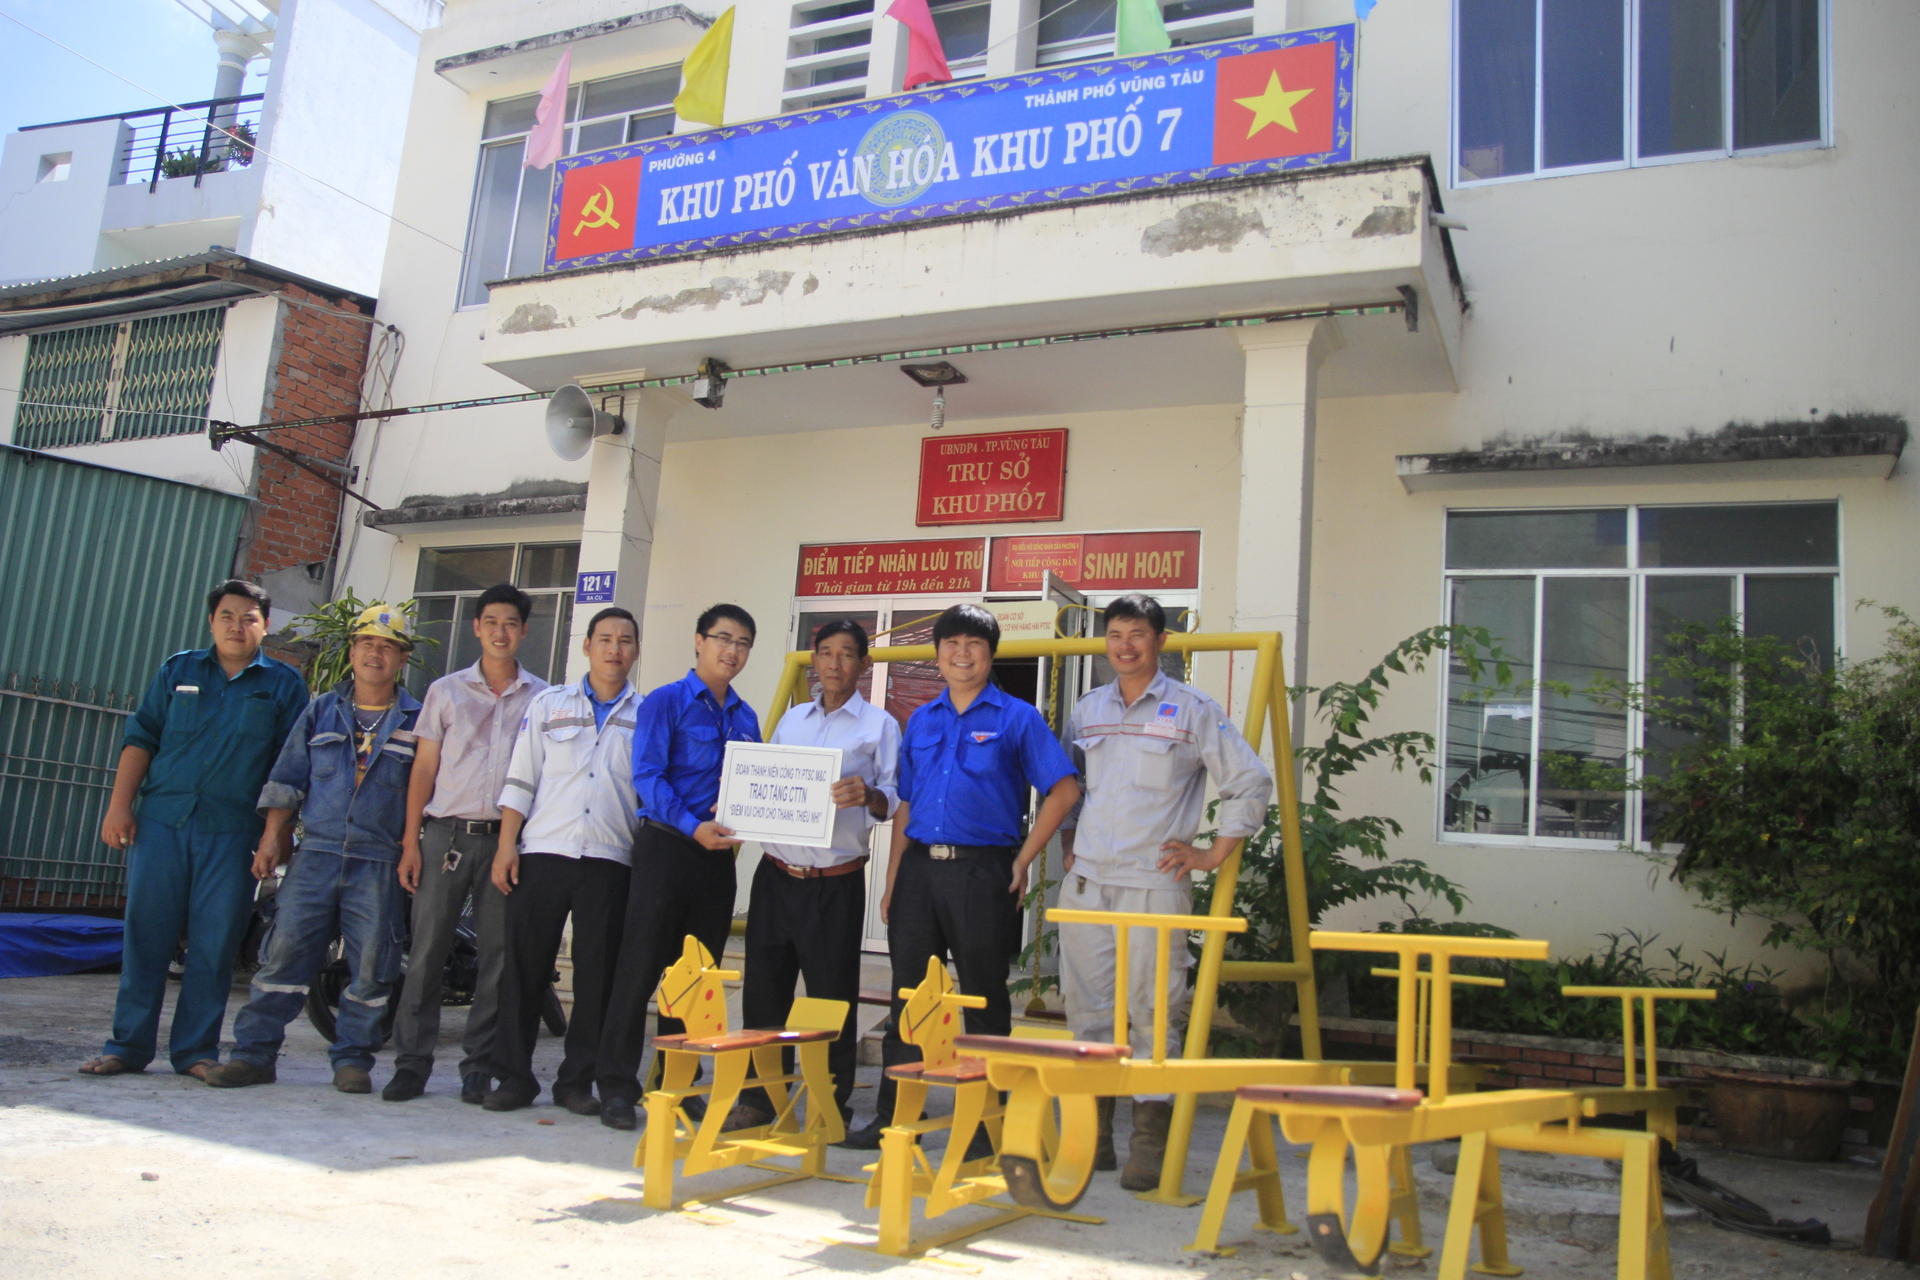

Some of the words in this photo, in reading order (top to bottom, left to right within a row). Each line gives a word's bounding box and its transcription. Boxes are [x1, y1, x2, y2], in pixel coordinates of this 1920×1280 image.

[1024, 86, 1078, 109] THÀNH
[1083, 78, 1116, 101] PHỐ
[1120, 74, 1166, 94] VŨNG
[1170, 67, 1204, 87] TÀU
[648, 152, 705, 173] PHƯỜNG
[707, 150, 717, 163] 4
[658, 179, 725, 225] KHU
[731, 150, 799, 214] PHỐ
[808, 147, 876, 200] VĂN
[885, 134, 960, 190] HÓA
[971, 126, 1053, 178] KHU
[1063, 96, 1144, 165] PHỐ
[1156, 107, 1183, 152] 7
[1030, 435, 1051, 449] TÀU
[947, 462, 994, 486] TRỤ
[1000, 452, 1031, 480] SỞ
[931, 494, 981, 515] KHU
[983, 482, 1033, 513] PHỐ
[1034, 492, 1046, 511] 7
[803, 548, 839, 576] ĐIỂM
[843, 547, 875, 574] TIẾP
[878, 549, 918, 577] NHẬN
[921, 549, 950, 572] LƯU
[954, 546, 984, 570] TRÚ
[1022, 571, 1040, 579] KHU
[1083, 552, 1128, 580] SINH
[1133, 550, 1185, 584] HOẠT
[815, 580, 843, 594] Thời
[845, 582, 873, 596] gian
[876, 580, 891, 592] từ
[895, 579, 917, 592] 19h
[920, 575, 945, 591] đến
[948, 577, 972, 590] 21h
[749, 782, 768, 800] TRAO
[789, 786, 808, 803] CTTN
